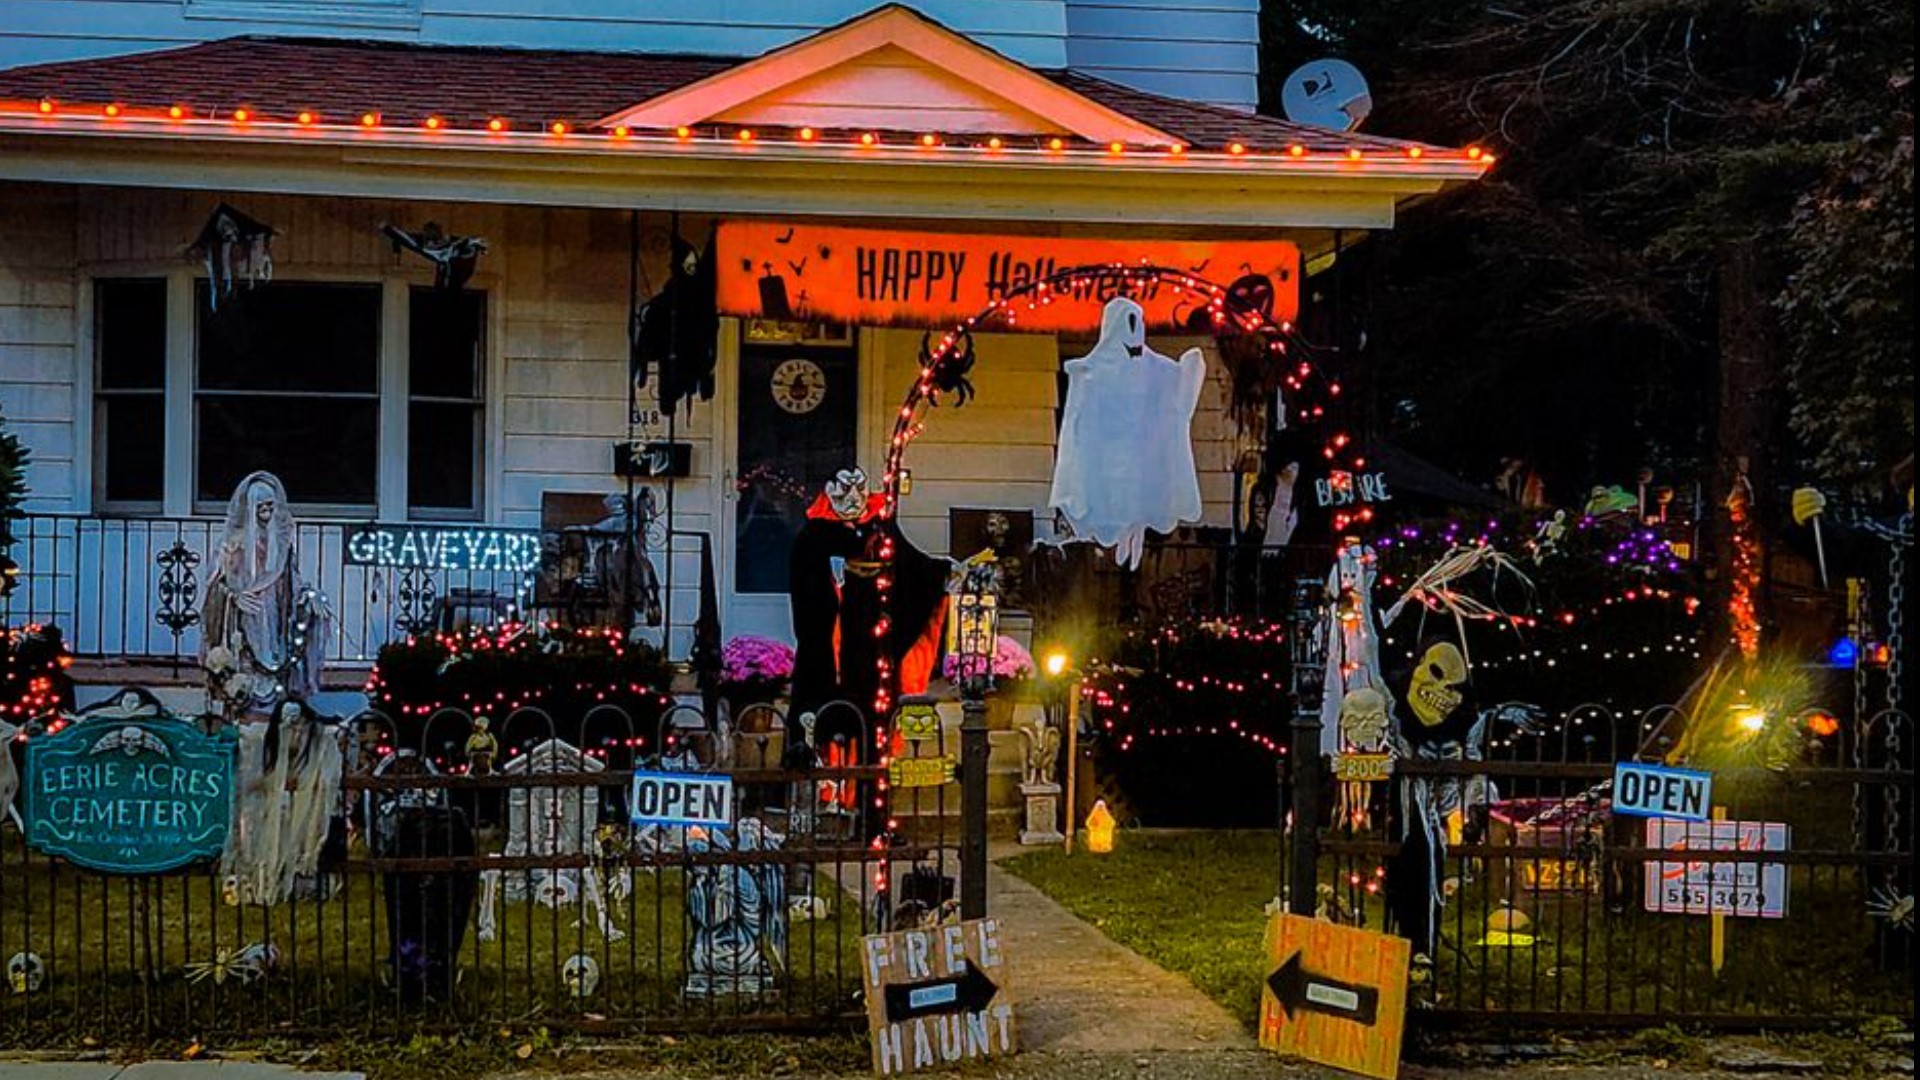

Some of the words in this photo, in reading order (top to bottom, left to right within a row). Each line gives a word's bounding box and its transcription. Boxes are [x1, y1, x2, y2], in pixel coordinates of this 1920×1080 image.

[857, 246, 965, 302] HAPPY
[630, 411, 659, 425] 318
[349, 530, 542, 572] GRAVEYARD
[42, 762, 120, 794] EERIE
[131, 763, 223, 797] ACRES
[638, 780, 725, 819] OPEN
[1619, 771, 1704, 814] OPEN
[50, 796, 207, 829] CEMETERY
[867, 919, 1003, 987] FREE
[879, 1004, 1012, 1074] HAUNT
